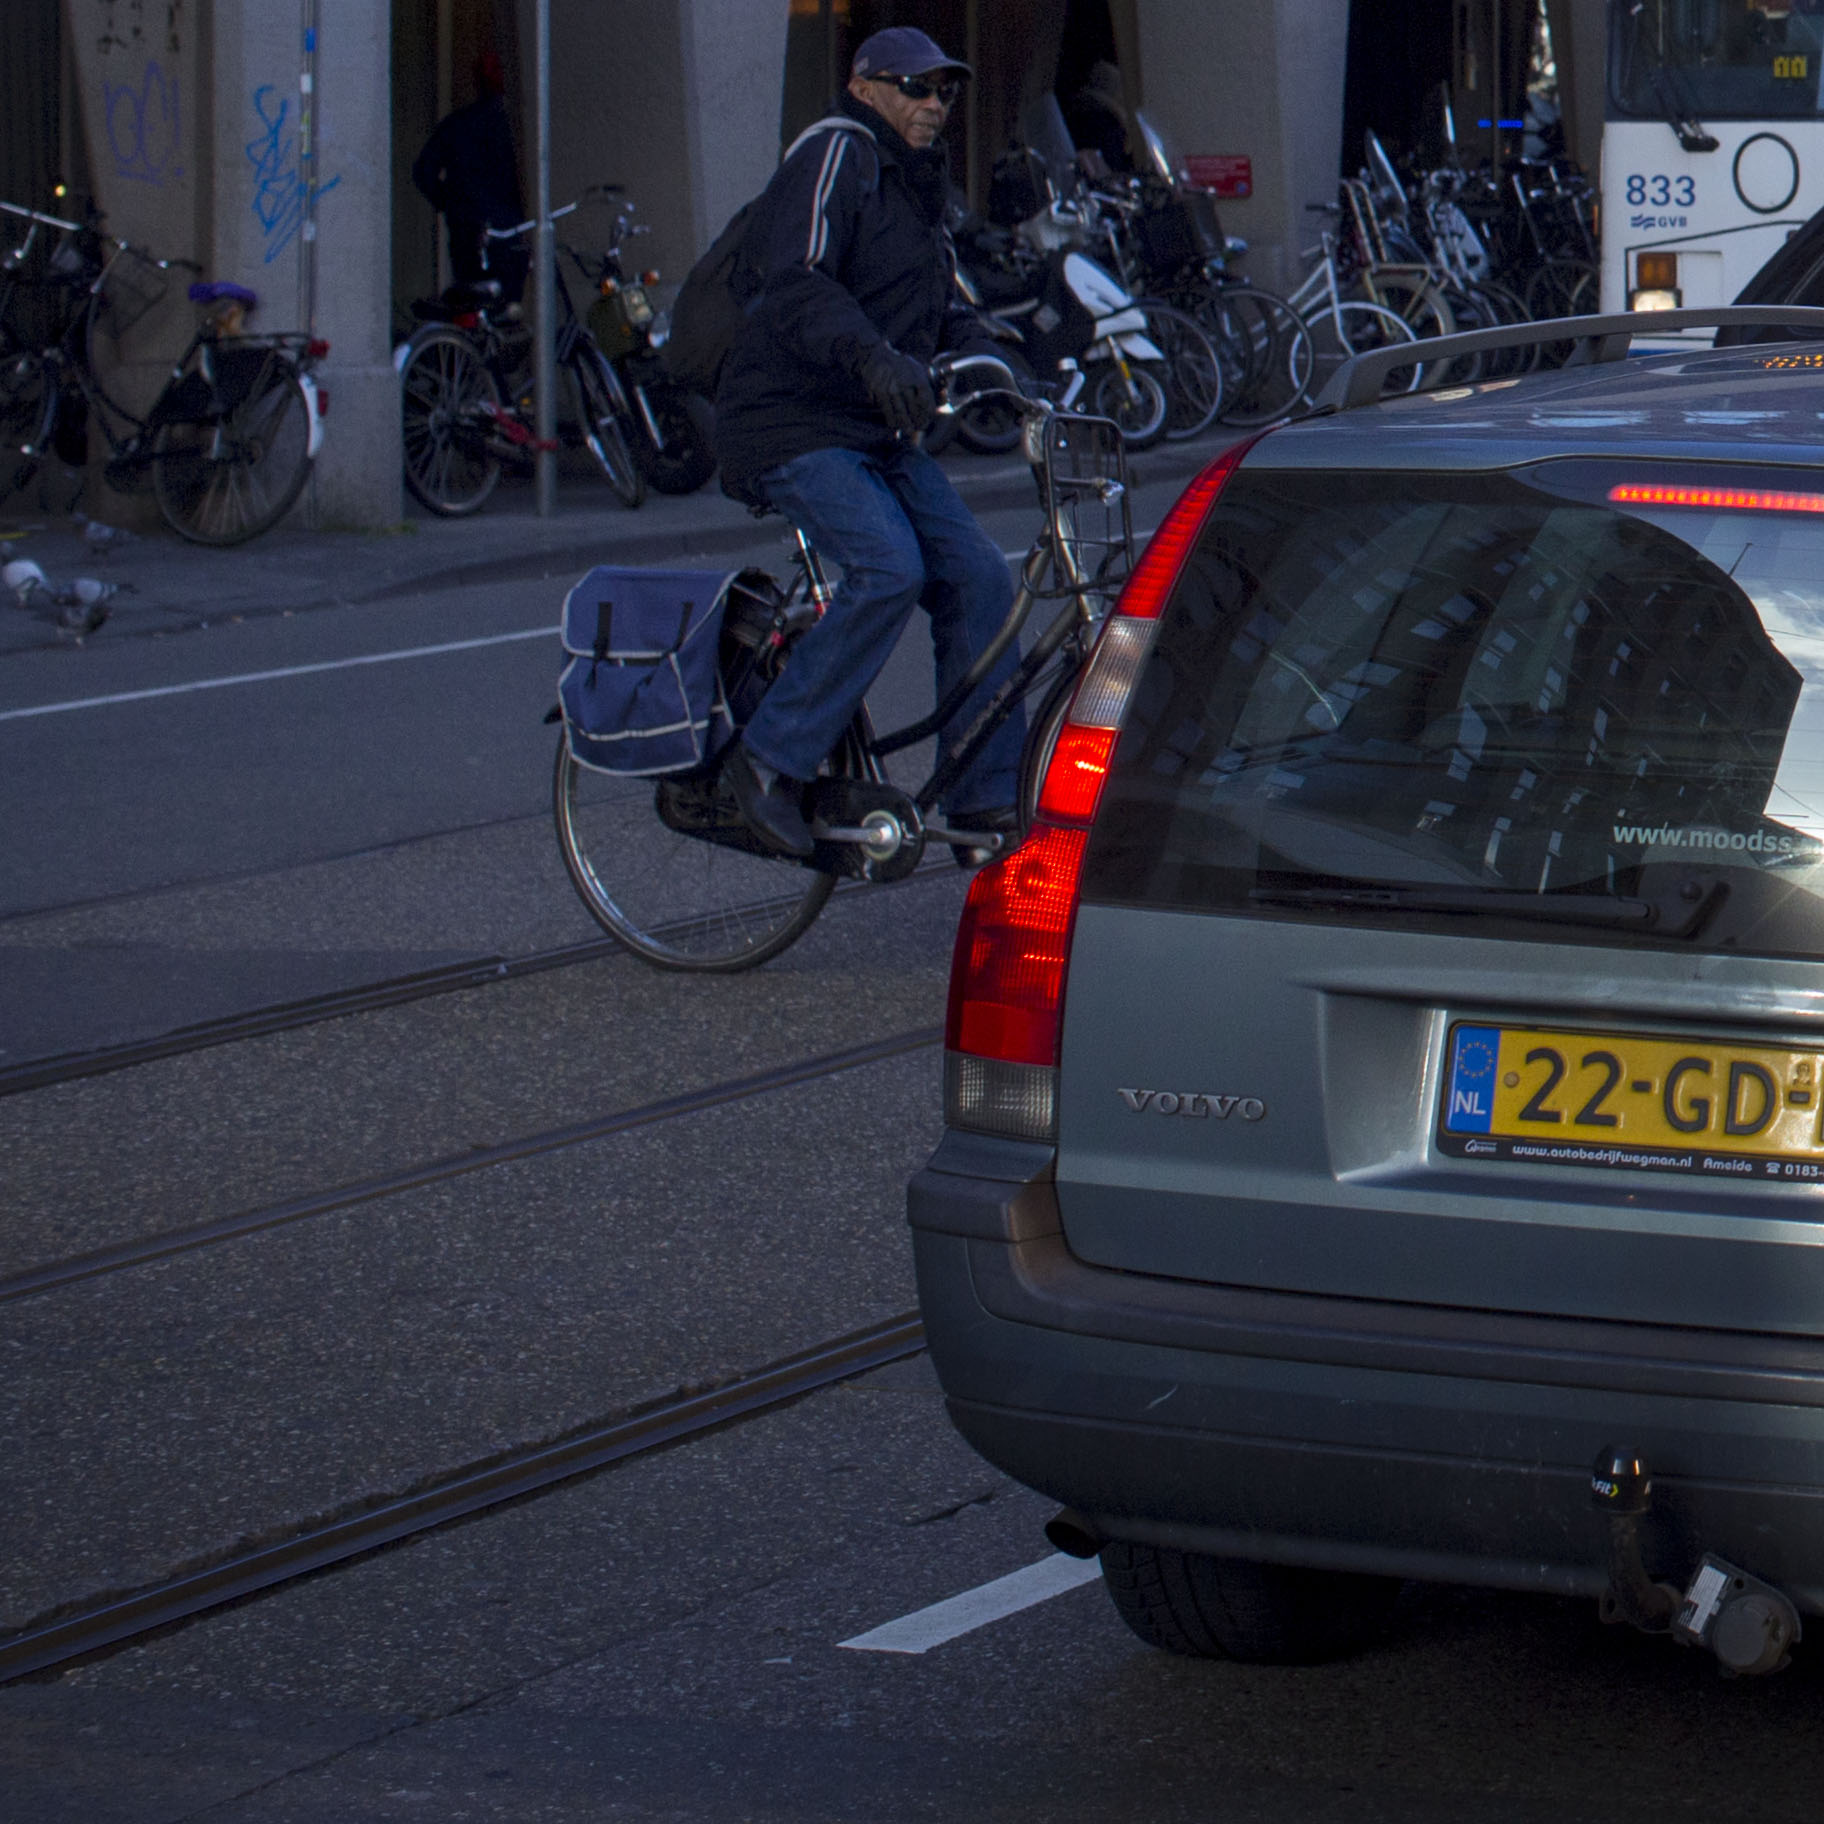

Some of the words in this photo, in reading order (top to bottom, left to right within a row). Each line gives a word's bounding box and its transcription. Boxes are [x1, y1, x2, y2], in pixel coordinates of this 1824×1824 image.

[1626, 174, 1695, 207] 833
[1657, 215, 1687, 227] GVB
[1117, 1087, 1266, 1122] VOLVO
[1454, 1090, 1487, 1116] NL
[1512, 1143, 1693, 1169] www.autobedrijfwegman.nl
[1703, 1156, 1753, 1173] Ameide
